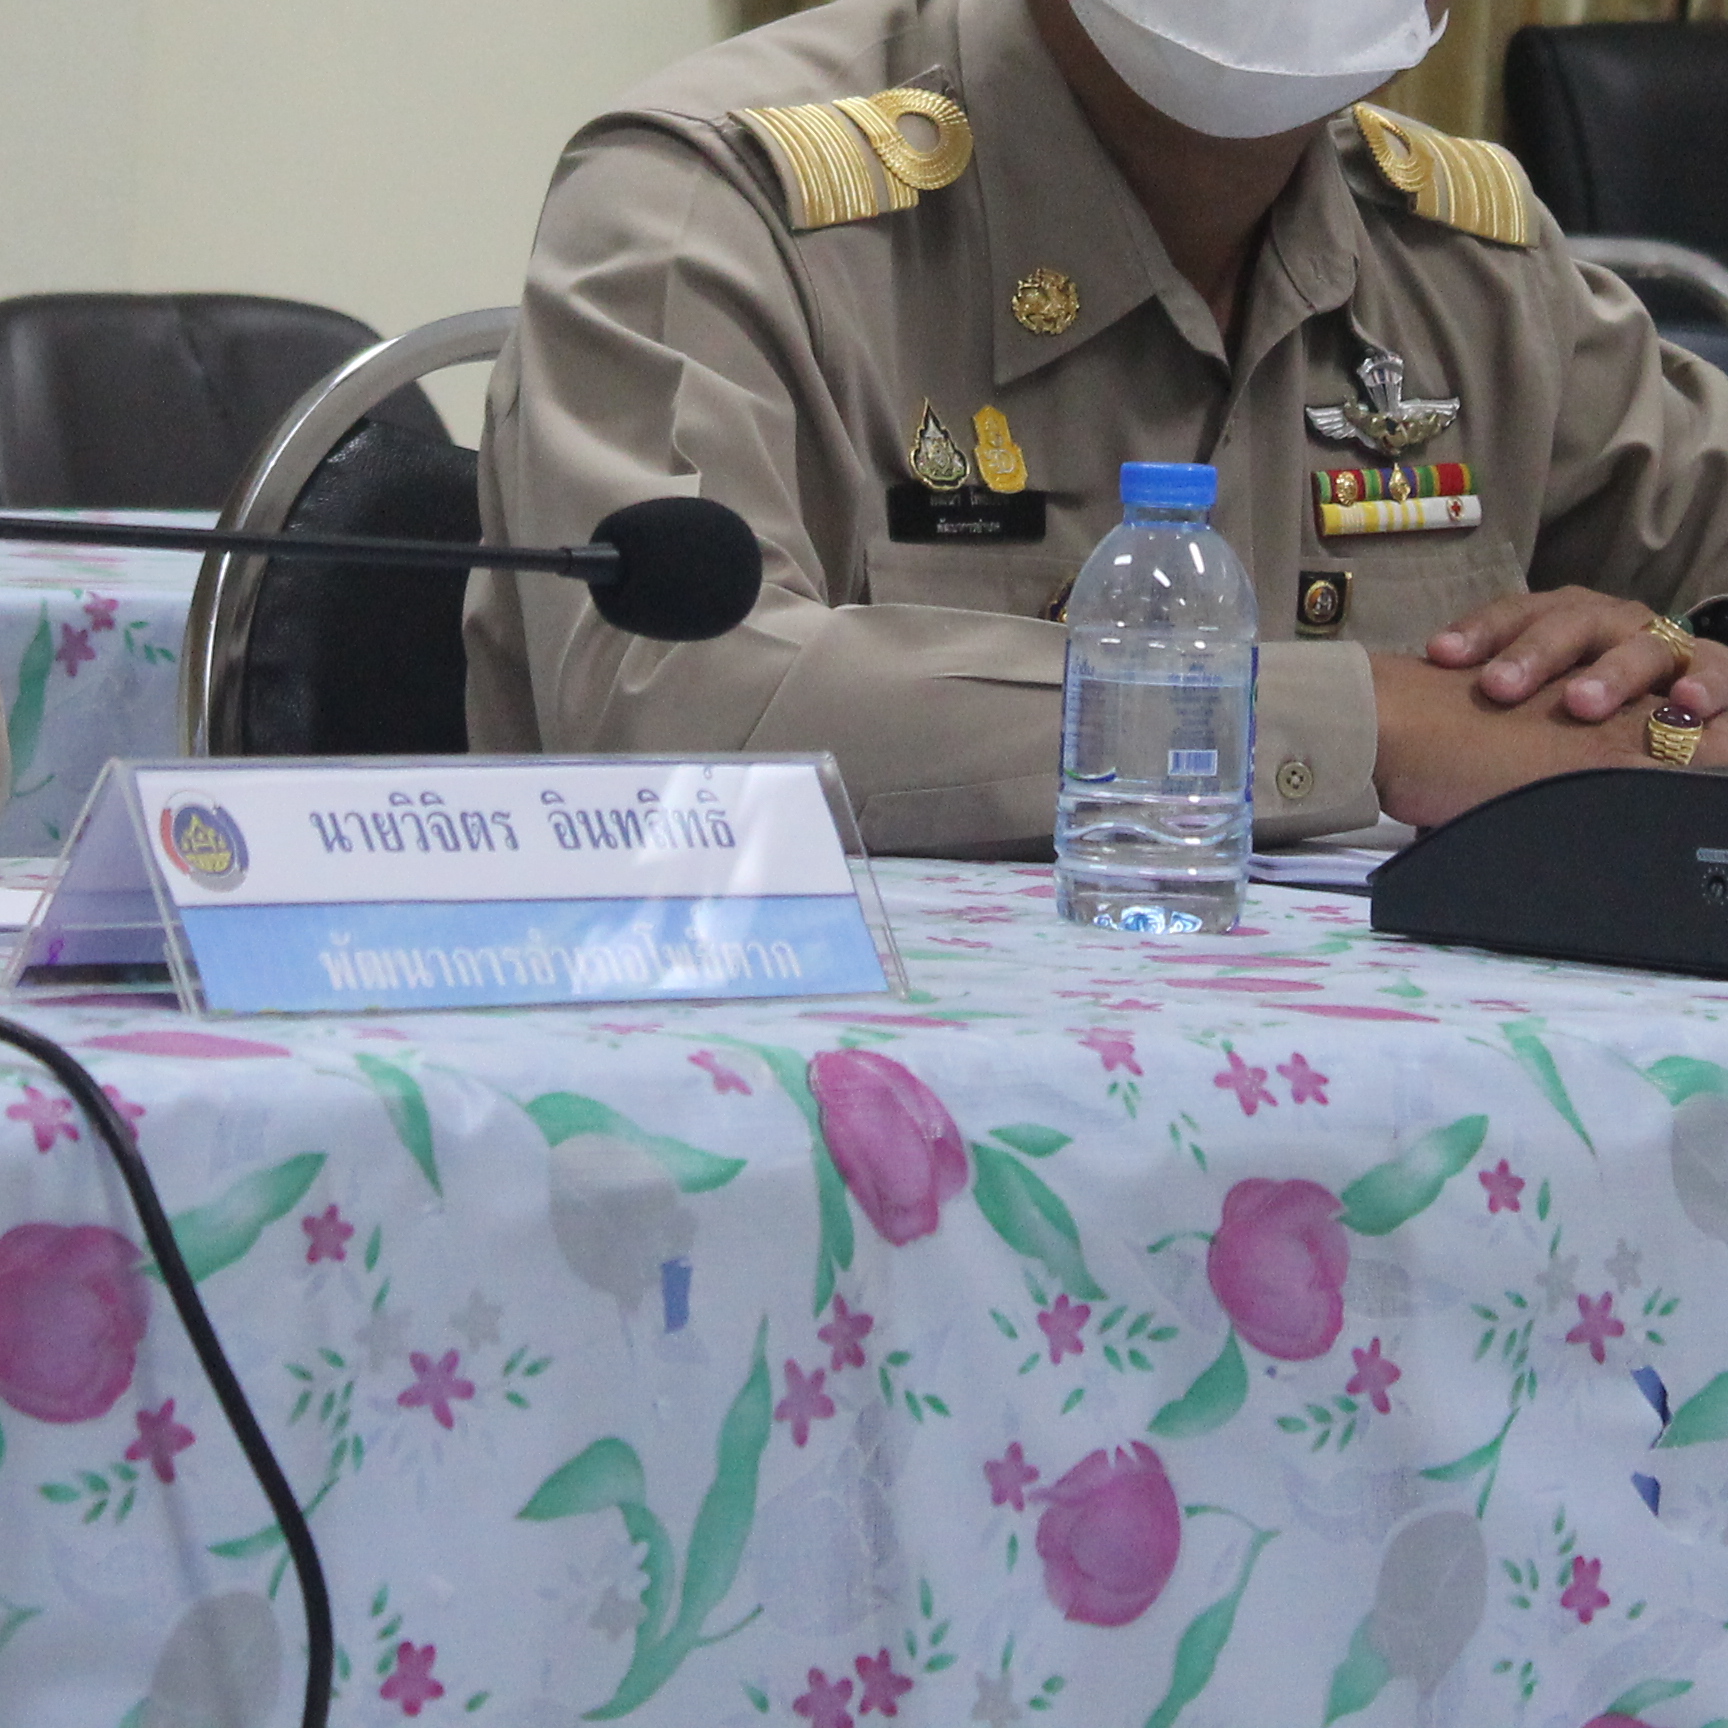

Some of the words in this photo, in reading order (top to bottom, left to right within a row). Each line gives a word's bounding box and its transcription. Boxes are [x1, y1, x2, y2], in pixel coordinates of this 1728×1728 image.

[308, 790, 520, 854] นายวิจิตร
[540, 765, 738, 852] อินทสิทธิ์
